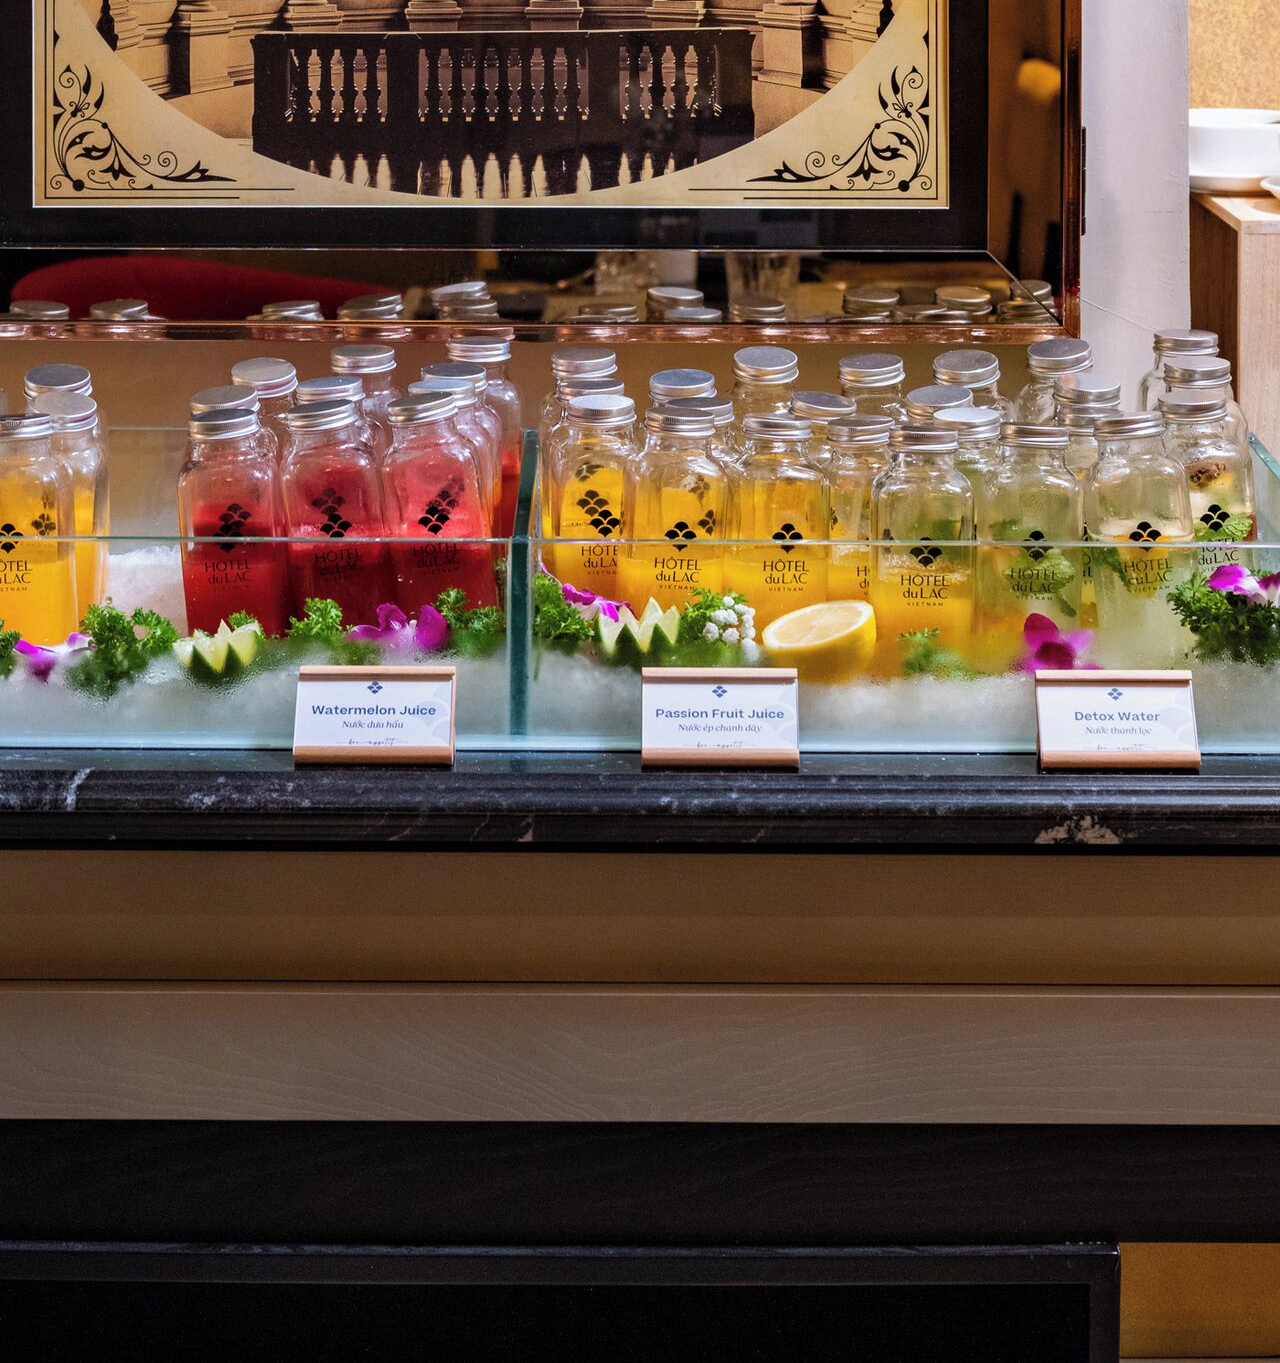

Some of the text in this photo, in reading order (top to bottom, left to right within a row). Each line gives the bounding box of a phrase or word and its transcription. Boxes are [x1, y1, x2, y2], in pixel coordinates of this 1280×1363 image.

[581, 544, 618, 557] HÔTE
[600, 557, 617, 568] LA
[654, 556, 702, 571] HÔTEL
[763, 559, 809, 572] HÔTEL
[900, 573, 950, 587] HÔTEL
[312, 705, 437, 716] Watermelon Juice
[655, 708, 785, 720] Passion Fruit Juice
[1074, 711, 1160, 722] Detox Water
[342, 719, 366, 729] Nước
[678, 723, 702, 732] Nước
[715, 723, 744, 732] chanh
